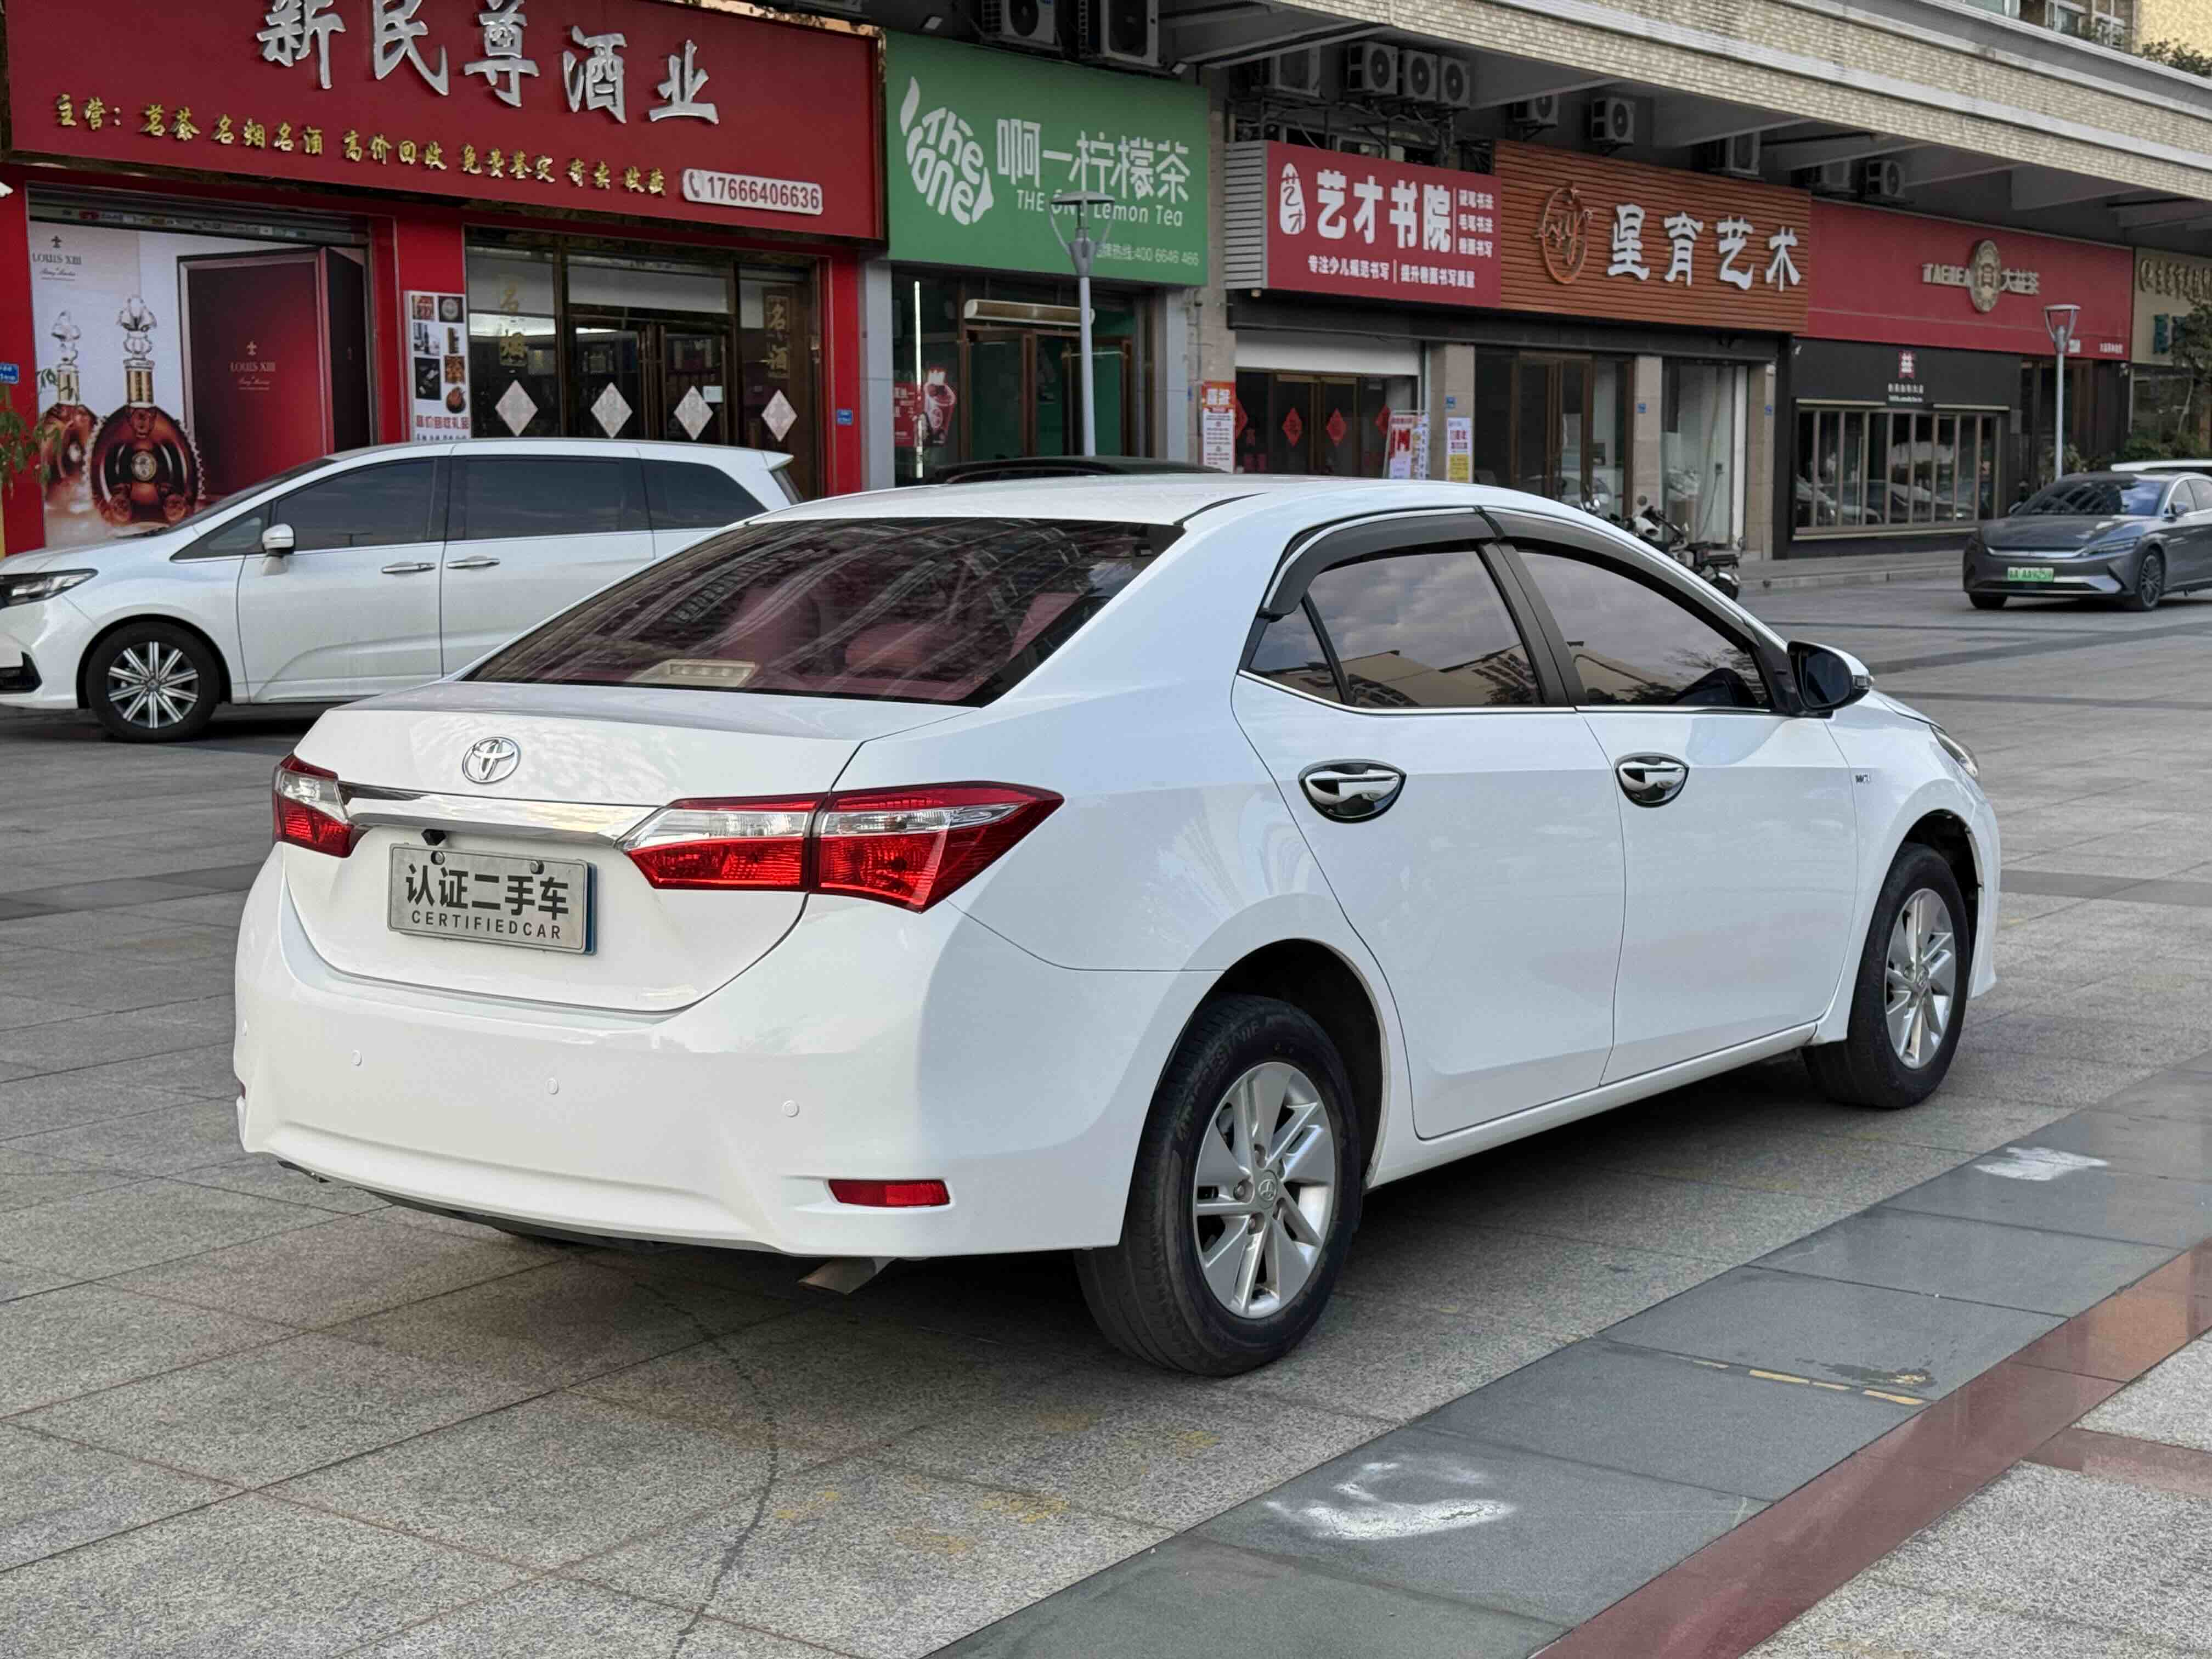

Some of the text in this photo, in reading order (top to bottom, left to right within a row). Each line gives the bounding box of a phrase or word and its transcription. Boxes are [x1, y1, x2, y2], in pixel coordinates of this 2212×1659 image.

[257, 0, 719, 124] 新民尊酒业
[343, 129, 447, 171] 高价回收
[996, 117, 1189, 204] 啊一柠檬茶
[707, 176, 820, 210] 17666406636
[1017, 189, 1045, 212] THE
[1093, 201, 1149, 223] Lemon
[1155, 204, 1183, 227] Tea
[1317, 168, 1451, 253] 艺才书院
[1607, 202, 1802, 292] 星育艺术
[405, 864, 569, 921] 认证二手车
[411, 910, 561, 940] CERTIFIEDCAR
